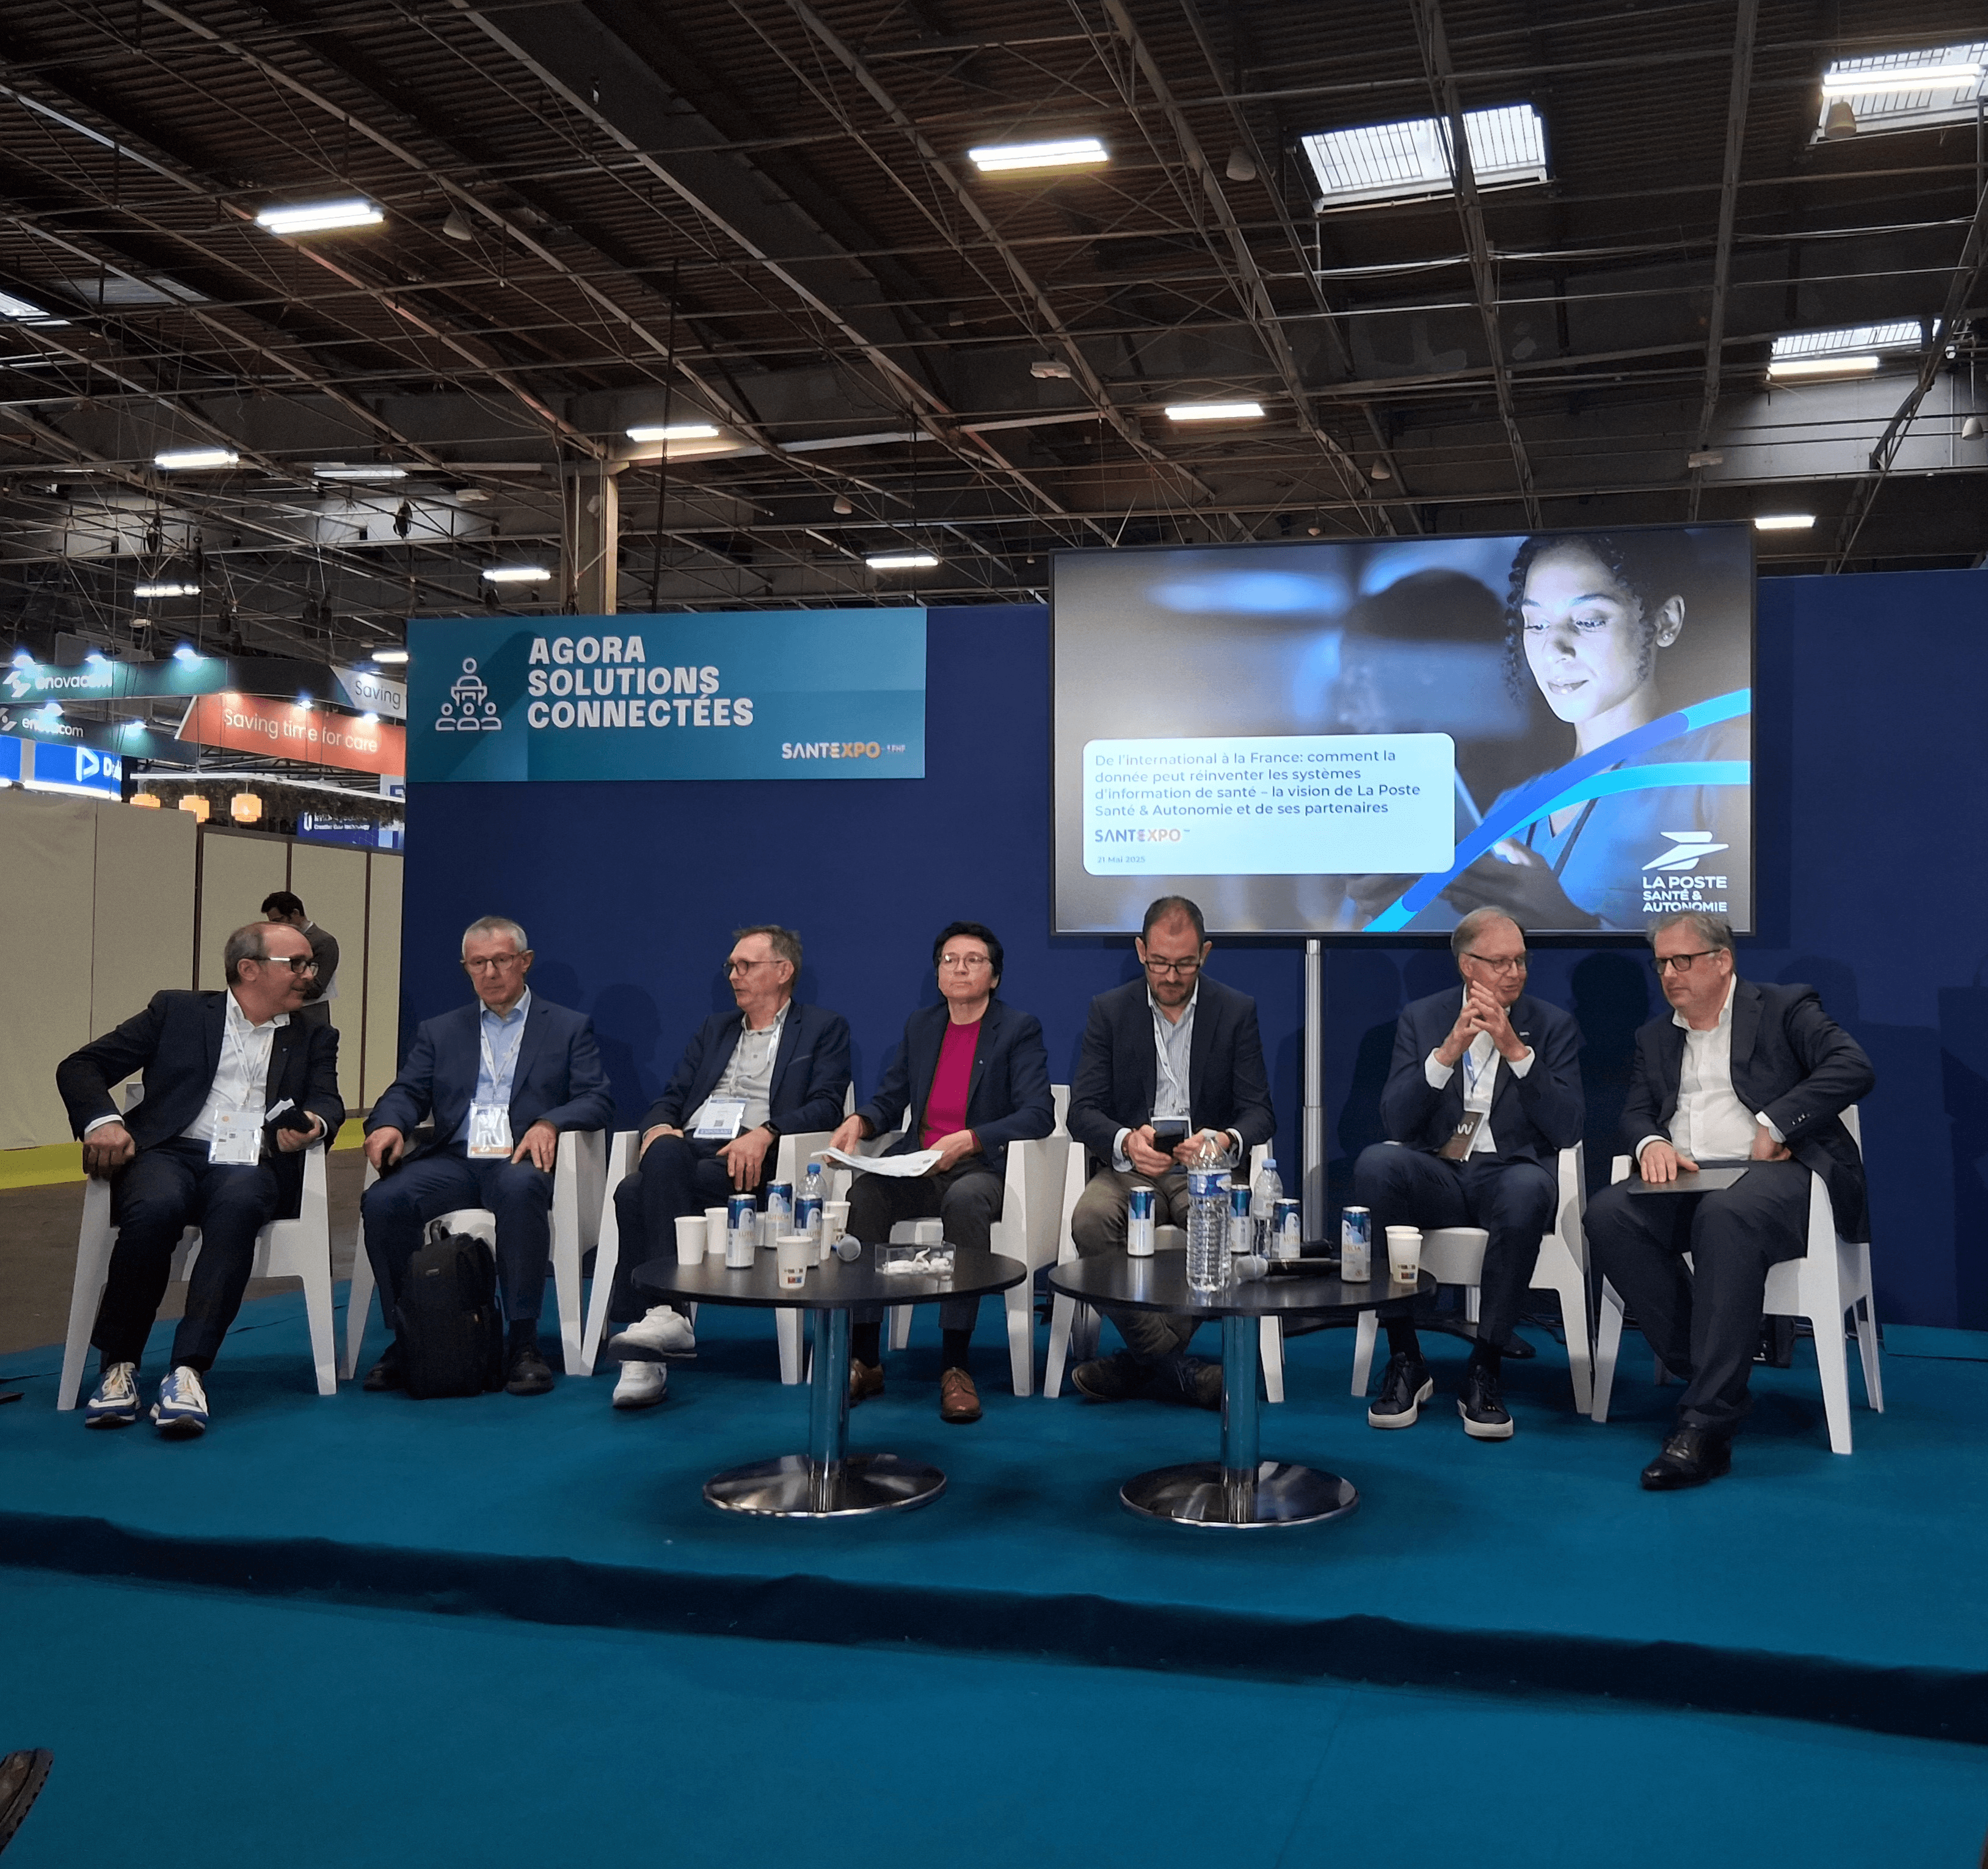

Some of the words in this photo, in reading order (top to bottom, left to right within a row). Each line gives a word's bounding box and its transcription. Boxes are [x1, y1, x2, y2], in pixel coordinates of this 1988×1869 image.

[529, 636, 646, 665] AGORA
[528, 666, 719, 697] SOLUTIONS
[355, 680, 401, 710] Saving
[527, 694, 754, 729] CONNECTÉES
[22, 718, 84, 737] encom
[225, 709, 279, 739] Saving
[283, 720, 318, 741] time
[322, 726, 341, 745] for
[344, 735, 378, 752] care
[782, 741, 881, 759] SANTEXPO
[1096, 755, 1114, 766] De
[1119, 753, 1217, 765] l'international
[1222, 752, 1229, 764] à
[1234, 752, 1245, 763] la
[1251, 752, 1303, 763] France:
[1307, 751, 1380, 762] comment
[1383, 750, 1396, 761] la
[1095, 771, 1149, 782] donnée
[1153, 772, 1185, 784] peut
[1190, 770, 1264, 781] réinventer
[1269, 768, 1288, 780] les
[1292, 768, 1361, 782] systèmes
[1095, 787, 1191, 800] d'information
[1195, 787, 1213, 798] de
[1217, 785, 1256, 798] santé
[1272, 785, 1284, 797] la
[1287, 785, 1330, 796] vision
[1334, 785, 1353, 796] de
[1358, 784, 1374, 796] La
[1378, 784, 1421, 796] Poste
[1095, 804, 1135, 816] Santé
[1140, 804, 1149, 815] &
[1152, 803, 1233, 815] Autonomie
[1237, 804, 1251, 815] et
[1255, 803, 1273, 814] de
[1277, 804, 1300, 814] ses
[1305, 801, 1388, 816] partenaires
[1094, 828, 1181, 842] SANTEXPO
[1643, 876, 1666, 889] LA
[1669, 876, 1728, 889] POSTE
[1643, 888, 1689, 901] SANTÉ
[1691, 890, 1702, 900] &
[1642, 902, 1728, 913] AUTONOMIE
